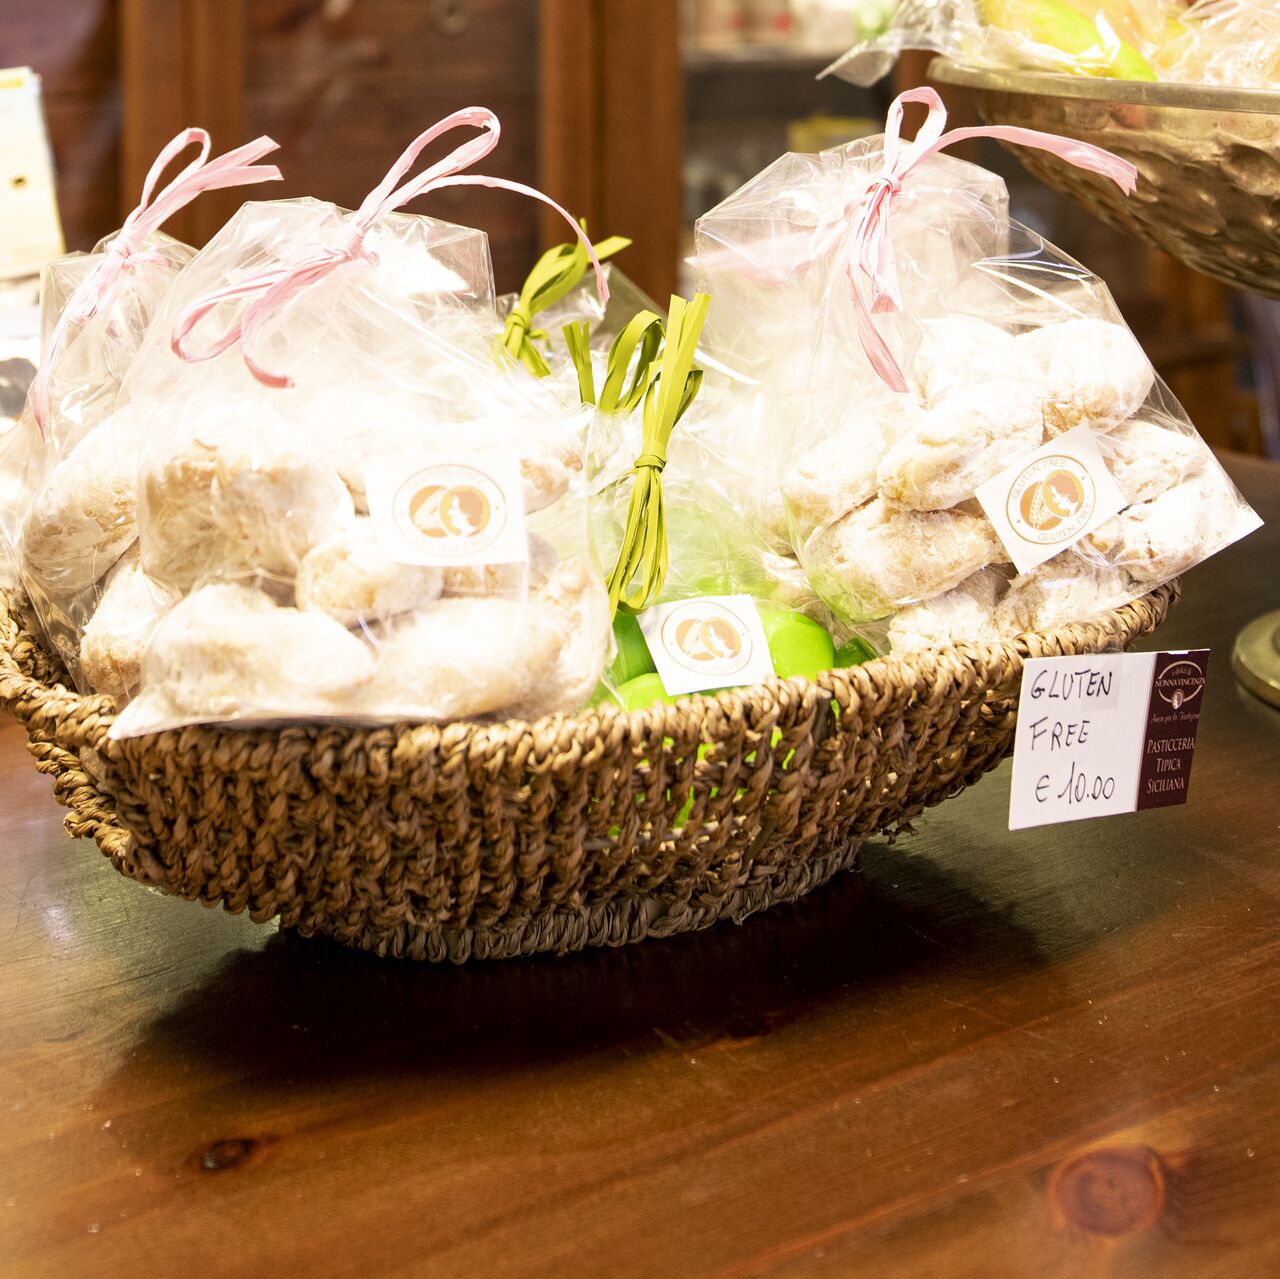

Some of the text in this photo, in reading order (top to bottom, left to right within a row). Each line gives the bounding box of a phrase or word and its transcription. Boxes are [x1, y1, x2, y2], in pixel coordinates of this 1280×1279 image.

[1012, 458, 1069, 499] GLUTEN FREE
[1038, 525, 1077, 543] GLUTEN
[1030, 669, 1113, 701] GLUTEN
[1029, 716, 1091, 751] FREE
[1147, 737, 1196, 755] PASTICCERIA
[1156, 757, 1182, 773] TIPICA
[1057, 760, 1116, 805] 10.00
[1146, 776, 1186, 795] SICILIANA
